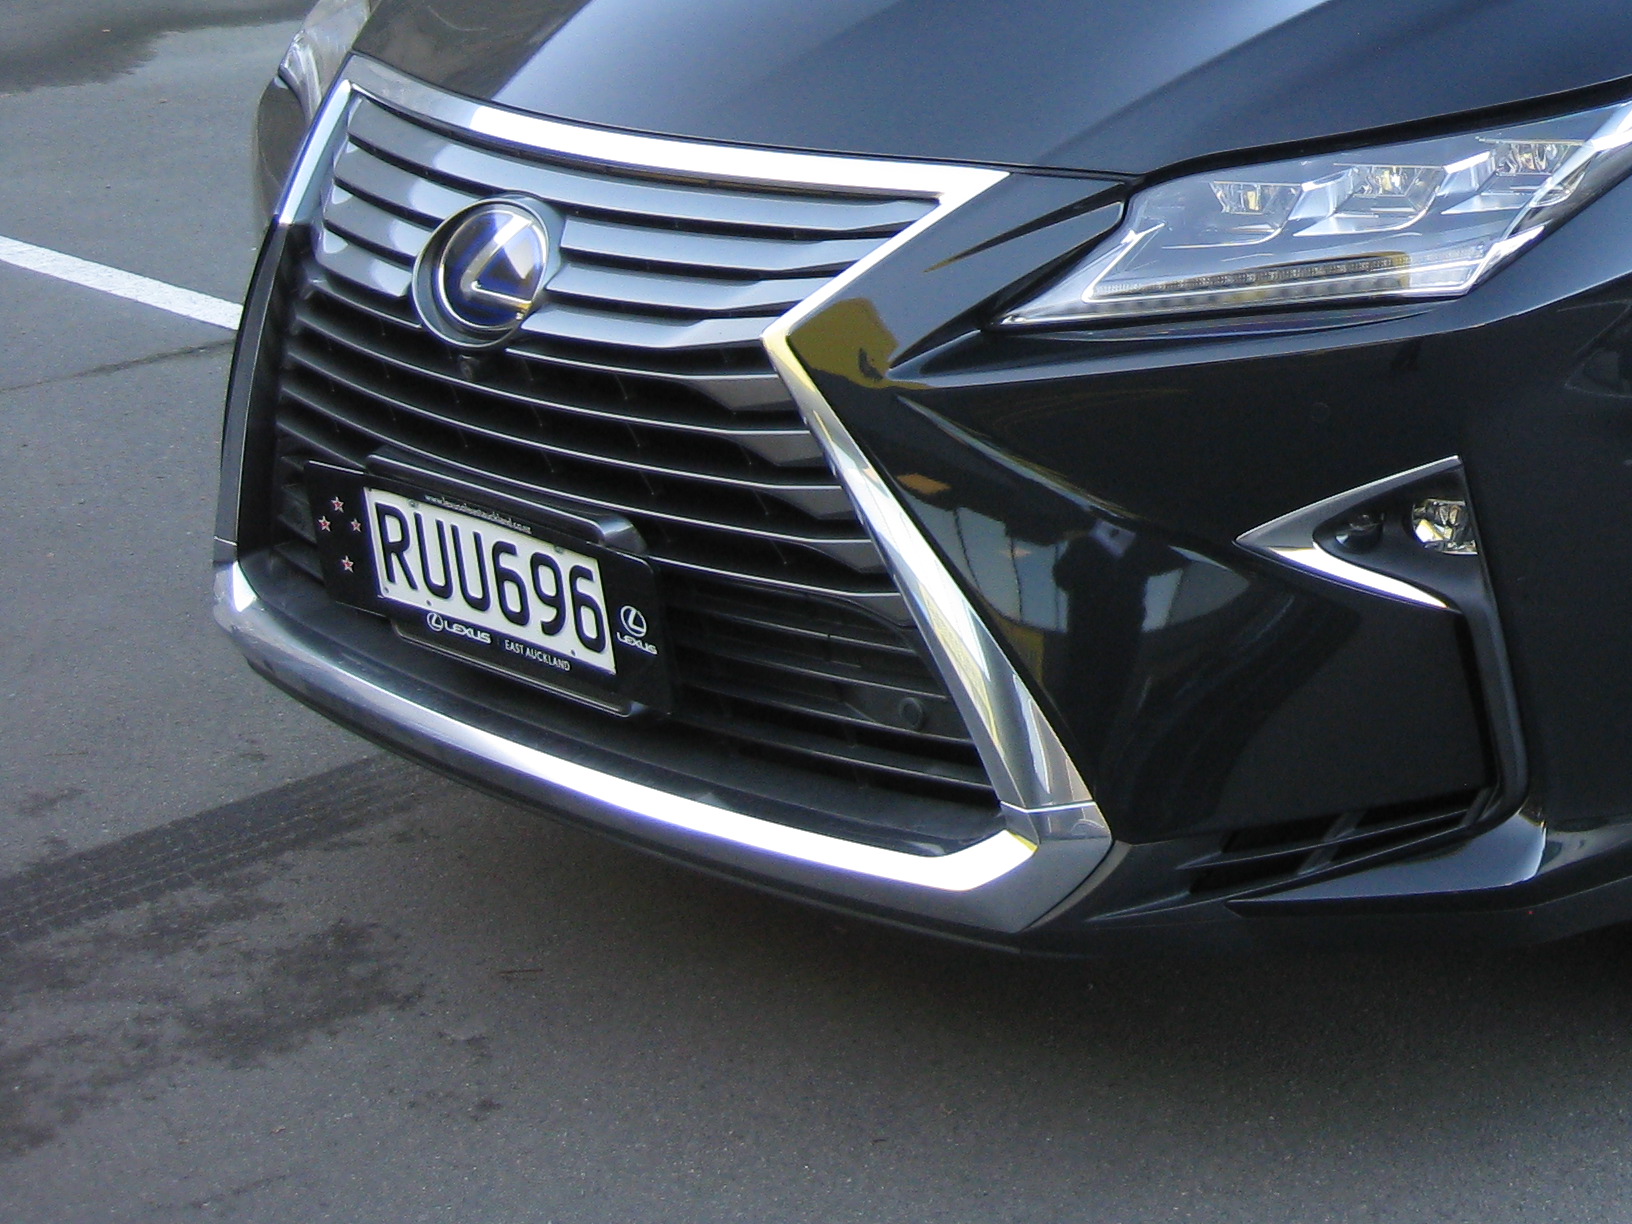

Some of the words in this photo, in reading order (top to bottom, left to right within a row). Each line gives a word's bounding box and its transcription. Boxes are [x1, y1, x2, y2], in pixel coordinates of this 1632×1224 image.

[374, 502, 607, 653] RUU696
[444, 619, 492, 644] LEXUS
[504, 639, 525, 654] EAST
[525, 647, 571, 672] AUCKLAND
[616, 631, 658, 655] LEXUS
